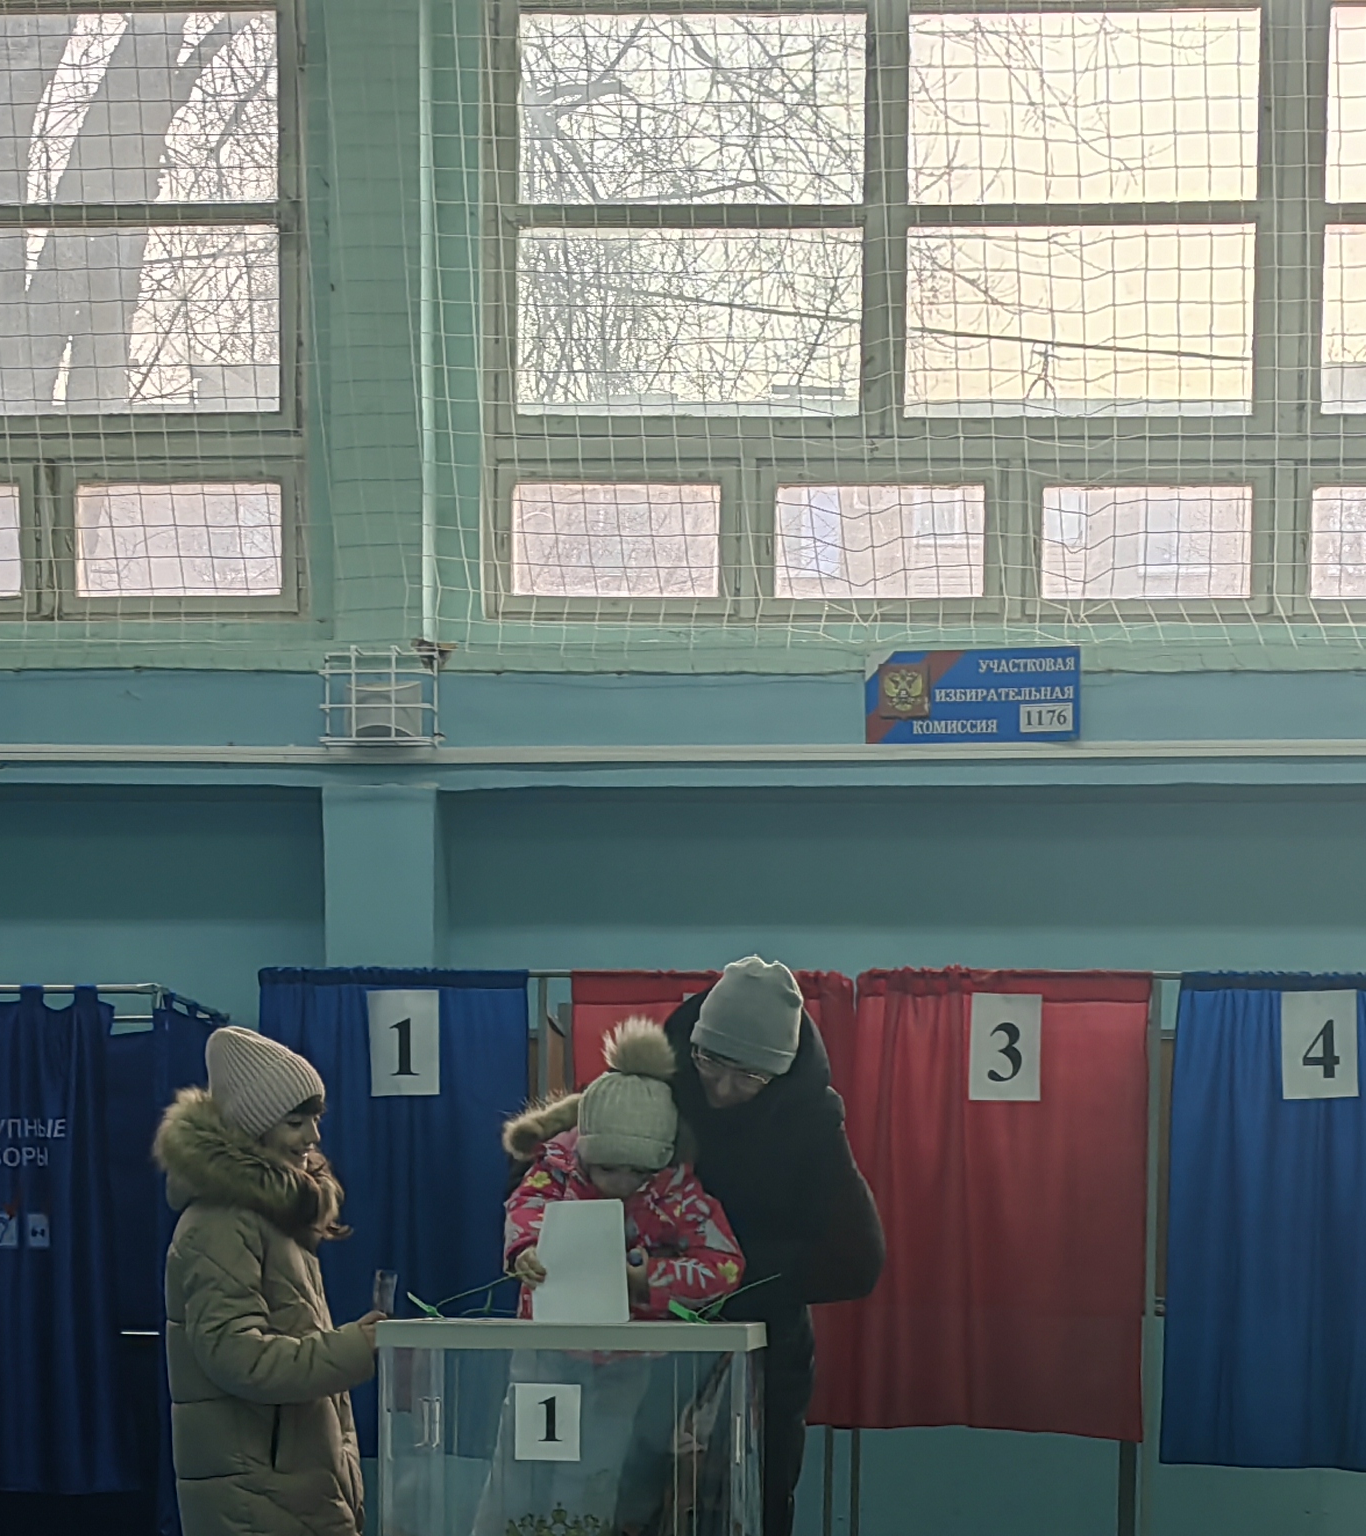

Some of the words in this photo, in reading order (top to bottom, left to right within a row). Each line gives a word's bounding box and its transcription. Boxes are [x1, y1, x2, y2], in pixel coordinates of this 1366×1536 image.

[979, 657, 1075, 672] УЧАСТКОВАЯ
[935, 686, 1074, 702] ИЗБИРАТЕЛЬНАЯ
[913, 719, 998, 734] КОМИССИЯ
[1026, 710, 1067, 726] 1176
[389, 1017, 420, 1077] 1
[986, 1021, 1023, 1082] 3
[1302, 1019, 1340, 1079] 4
[538, 1395, 563, 1442] 1
